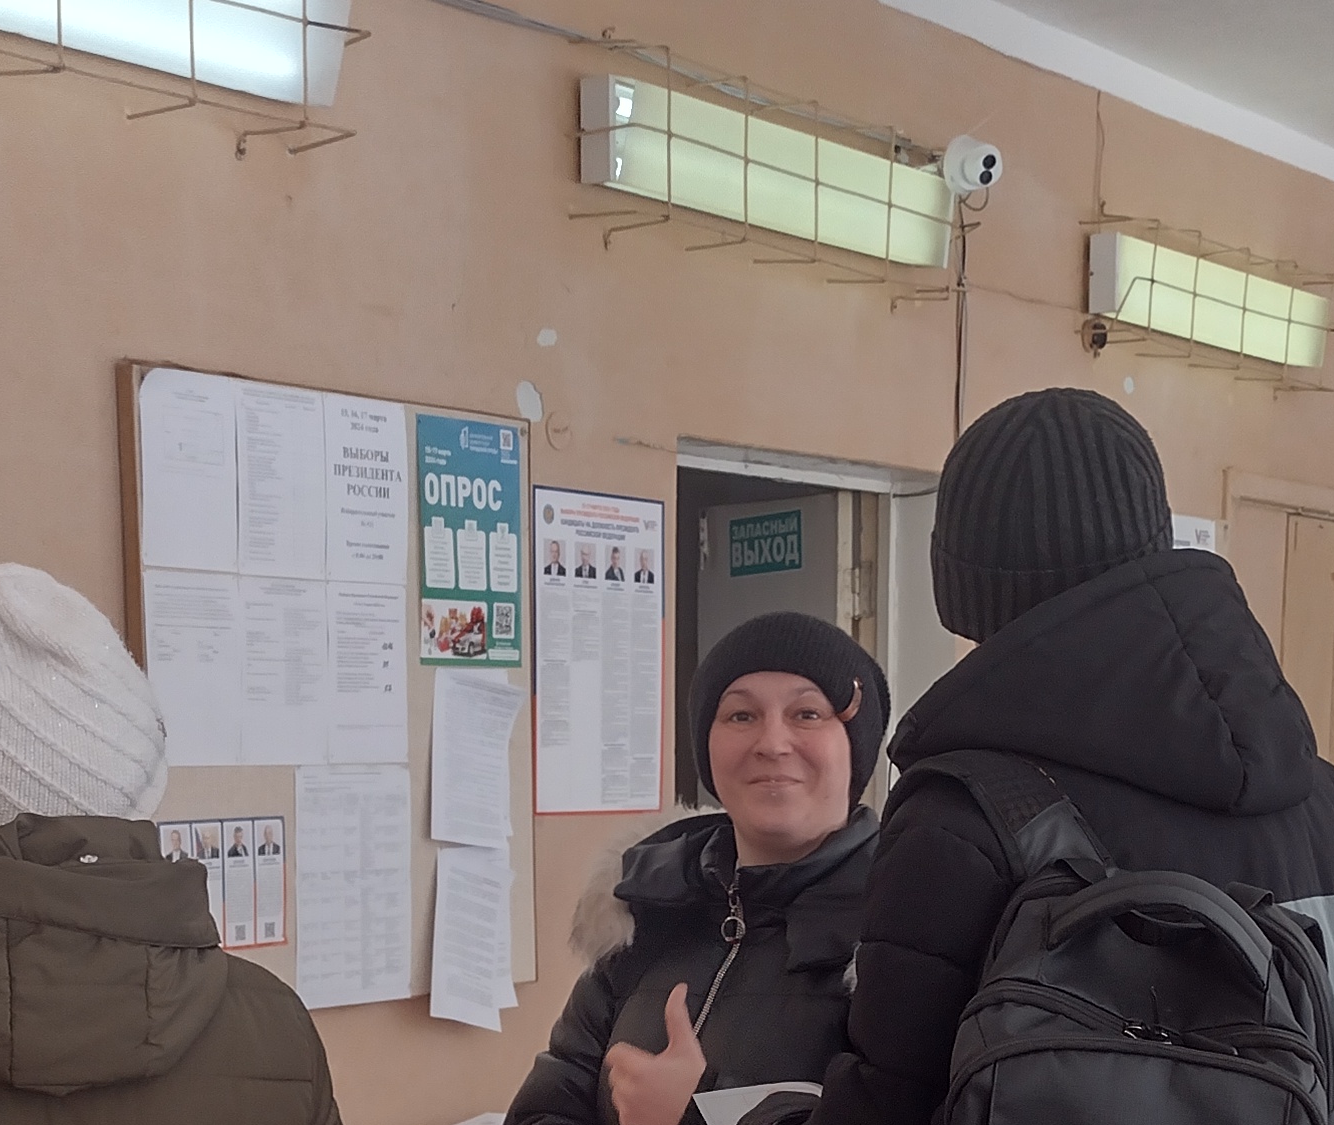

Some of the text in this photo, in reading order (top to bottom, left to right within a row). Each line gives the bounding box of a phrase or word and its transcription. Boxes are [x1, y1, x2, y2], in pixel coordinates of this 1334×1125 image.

[342, 446, 389, 463] ВЫБОРЫ
[333, 464, 402, 483] ПРЕЗИДЕНТА
[346, 483, 390, 499] РОССИИ
[424, 472, 503, 511] ОПРОС
[732, 513, 798, 539] ЗАПАСНЫЙ
[731, 533, 800, 568] ВЫХОД
